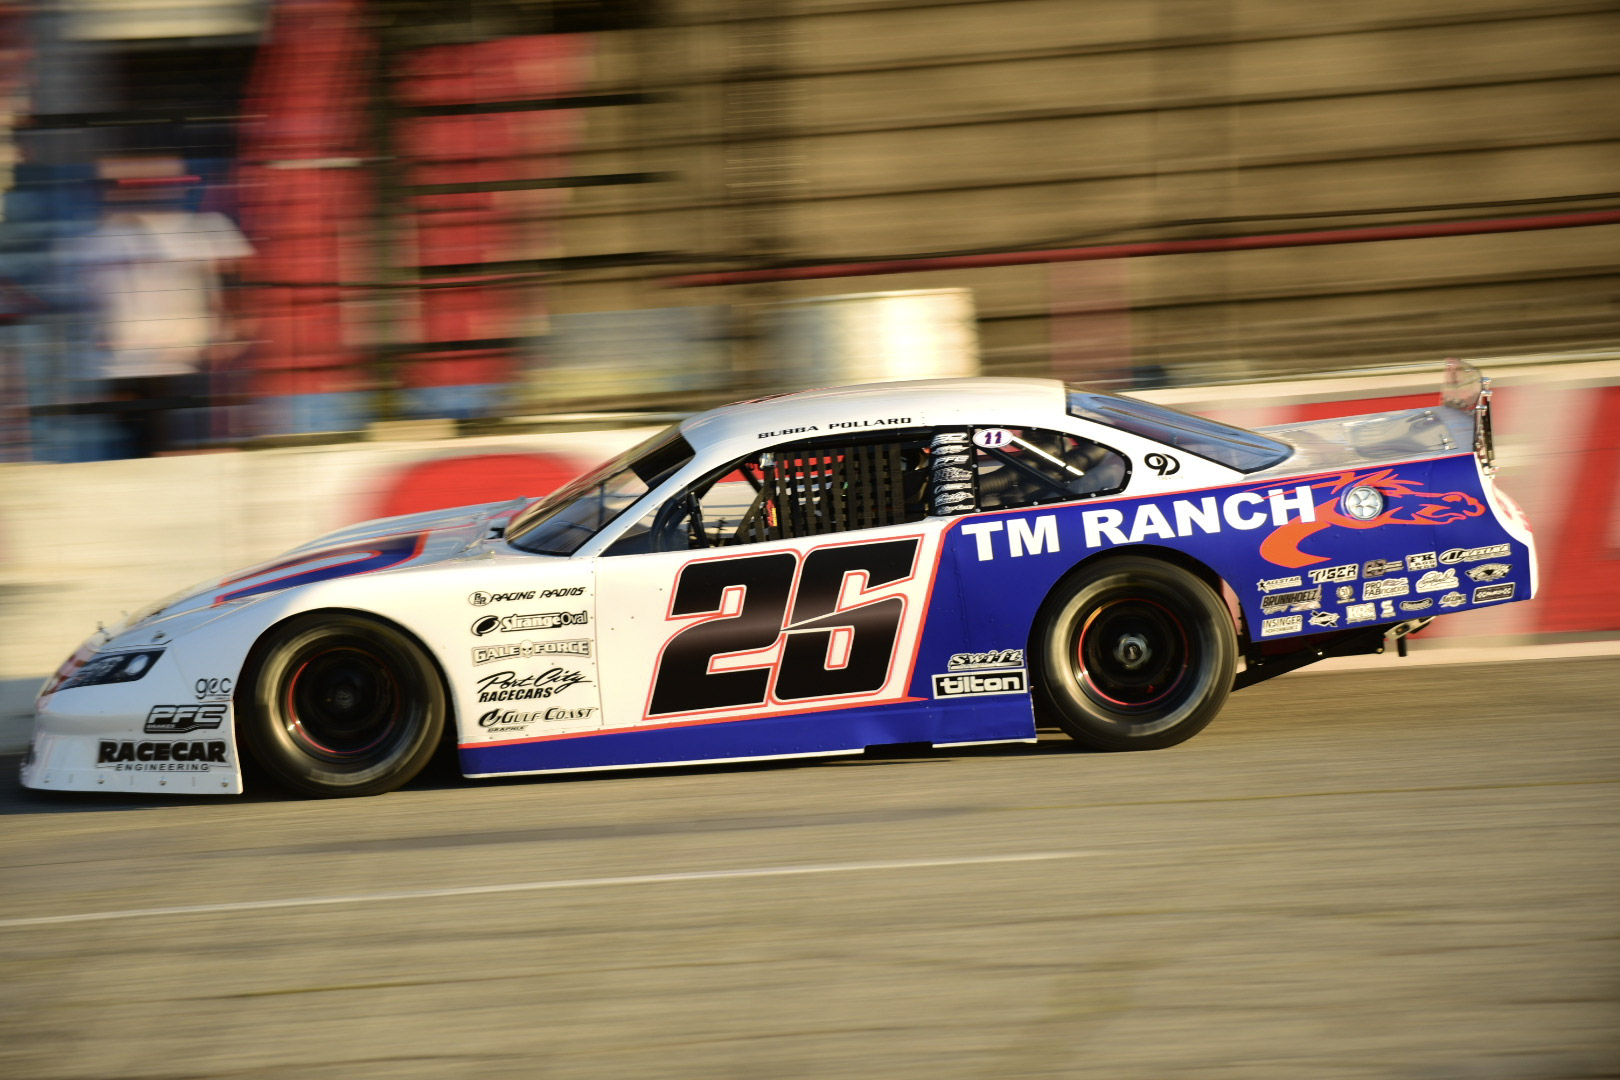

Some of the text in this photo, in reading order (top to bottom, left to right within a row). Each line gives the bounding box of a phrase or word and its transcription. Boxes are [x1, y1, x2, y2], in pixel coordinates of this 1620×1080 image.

[758, 417, 912, 439] BUBBA POLLARD
[985, 431, 1002, 445] 11
[961, 485, 1316, 562] TM RANCH
[1309, 564, 1357, 581] TIGER
[490, 587, 586, 602] RACING RADIOS
[645, 536, 922, 718] 26
[1263, 616, 1302, 628] INSINGER
[474, 641, 589, 663] GALE FORCE
[195, 678, 231, 700] gec
[477, 667, 593, 694] Port City
[940, 675, 1020, 694] tilton
[478, 686, 553, 703] RACECARS
[147, 704, 226, 725] PFC
[98, 740, 226, 764] RACECAR
[115, 762, 210, 772] ENGINEERING
